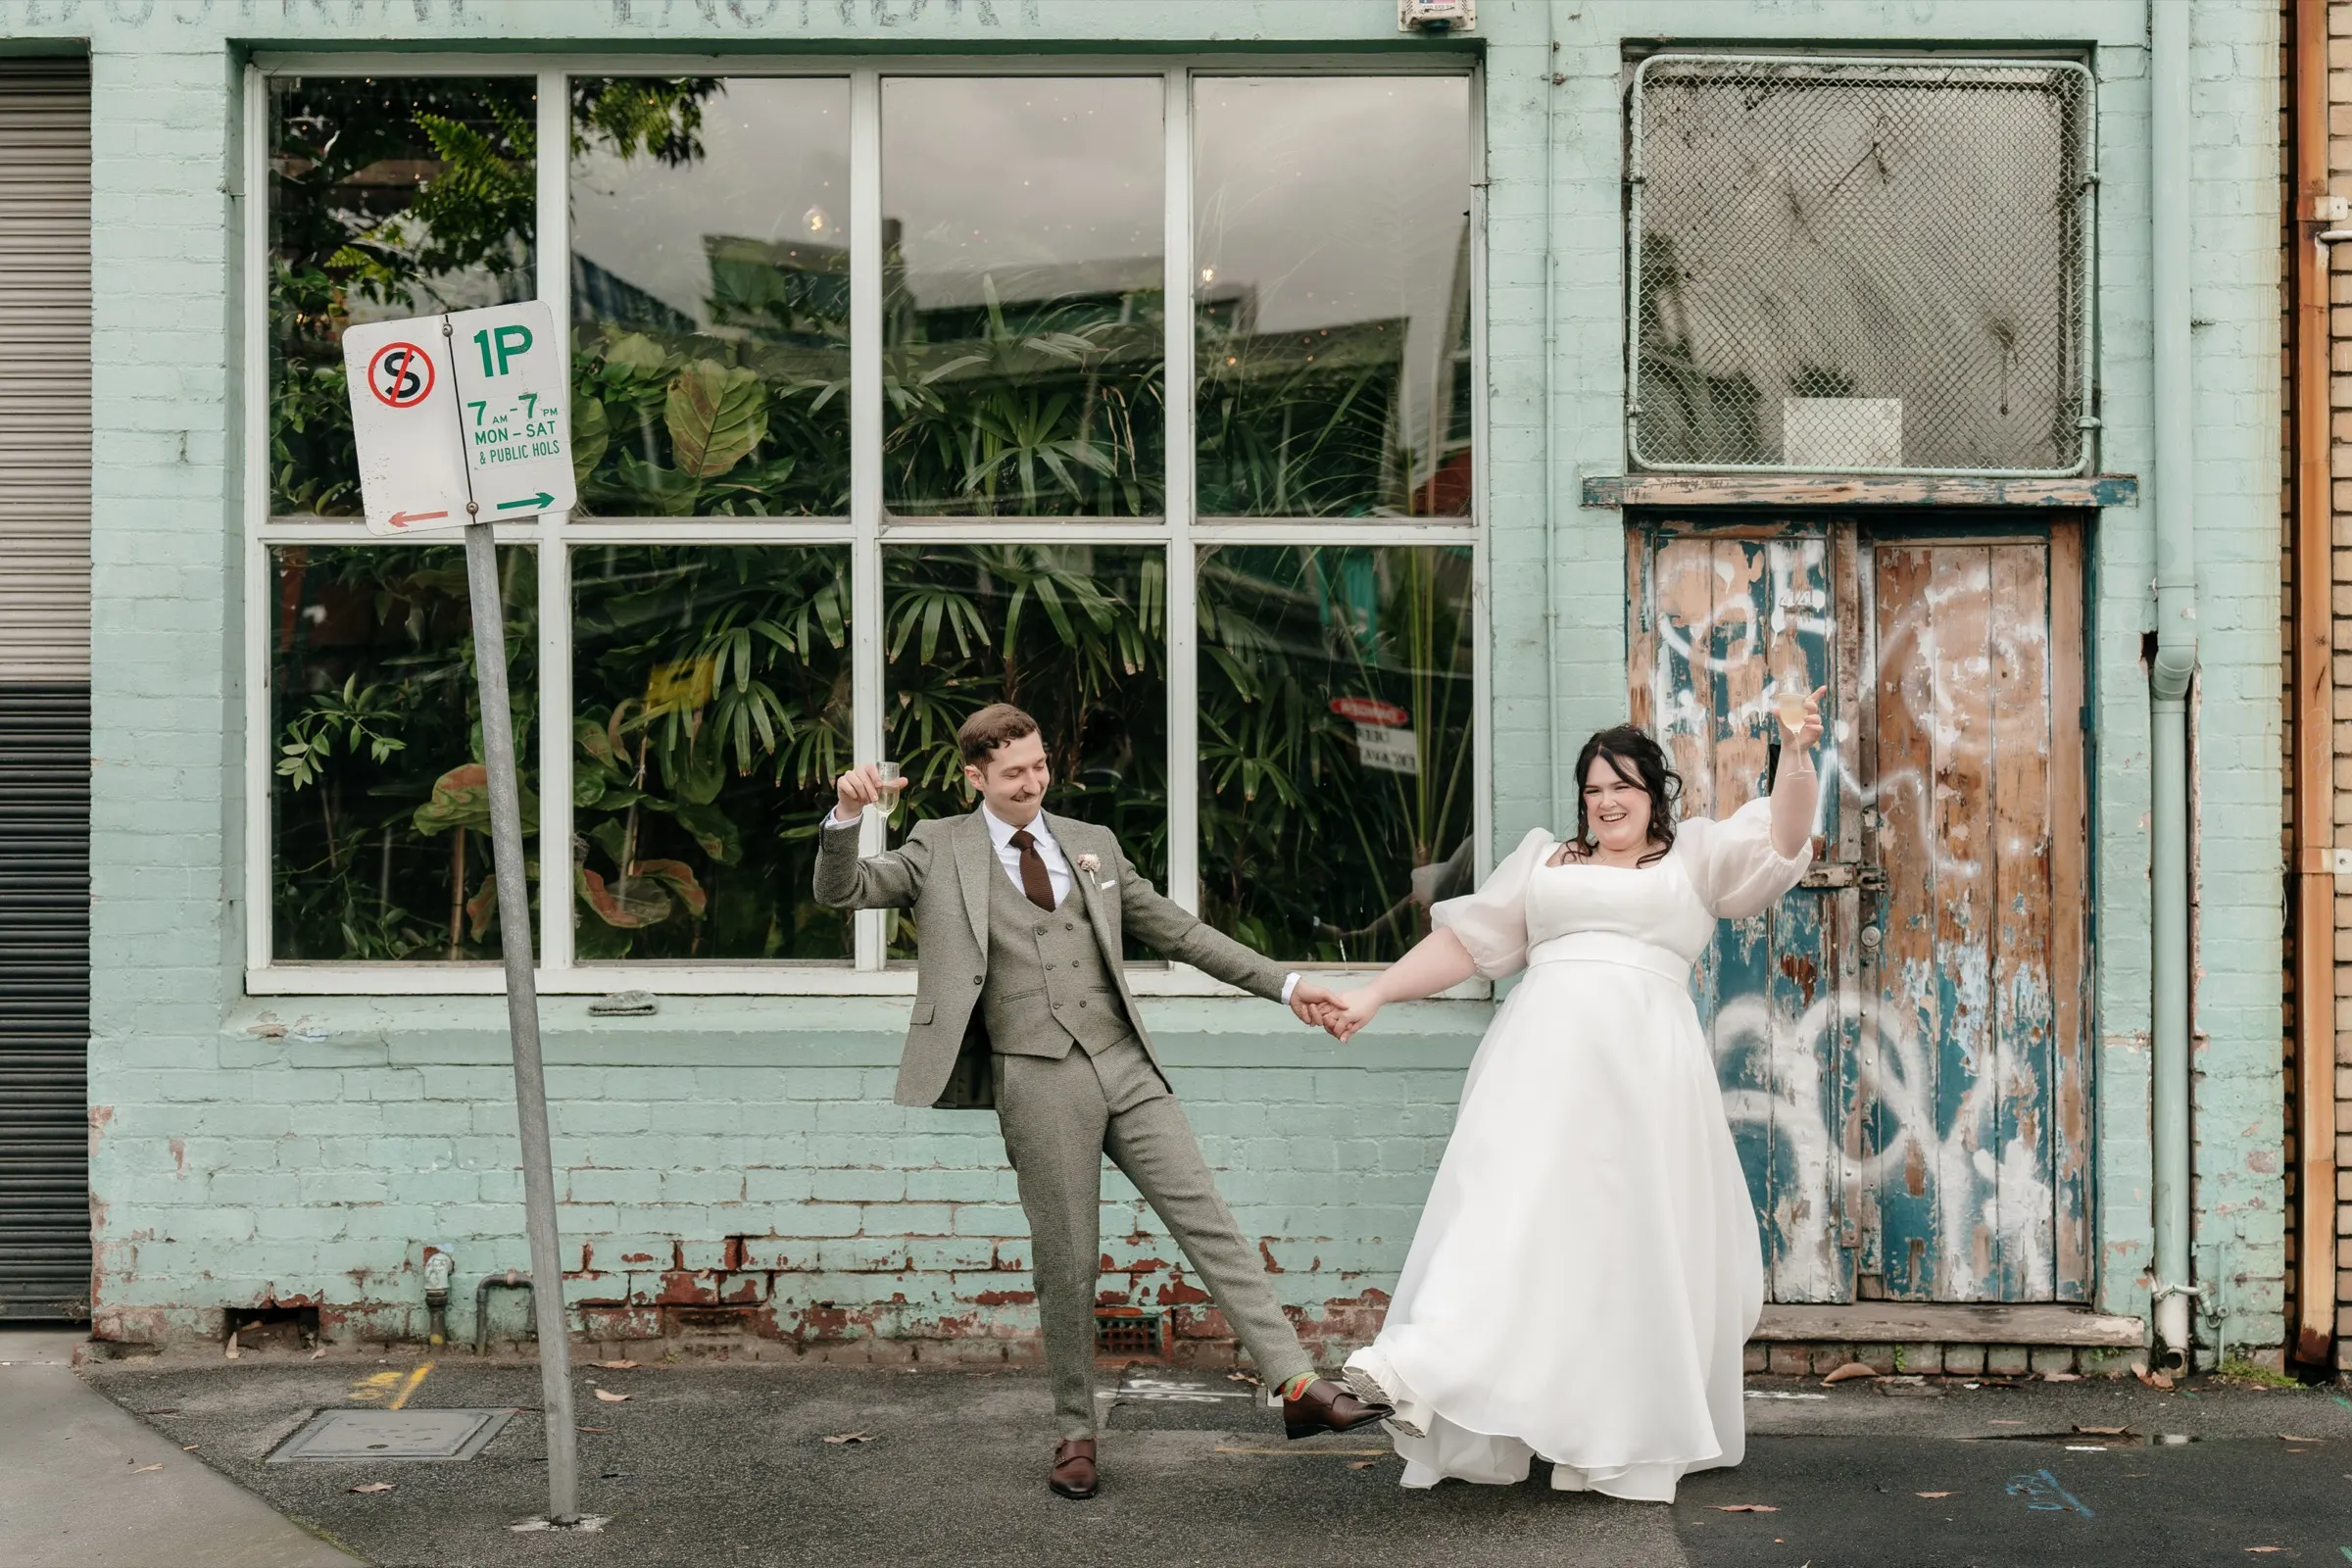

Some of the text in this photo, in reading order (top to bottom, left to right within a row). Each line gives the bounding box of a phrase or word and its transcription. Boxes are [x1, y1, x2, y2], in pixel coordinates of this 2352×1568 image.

[473, 324, 533, 378] 1P
[474, 427, 509, 446] MON
[525, 420, 556, 438] SAT
[479, 439, 561, 466] & PUBLIC HOLS
